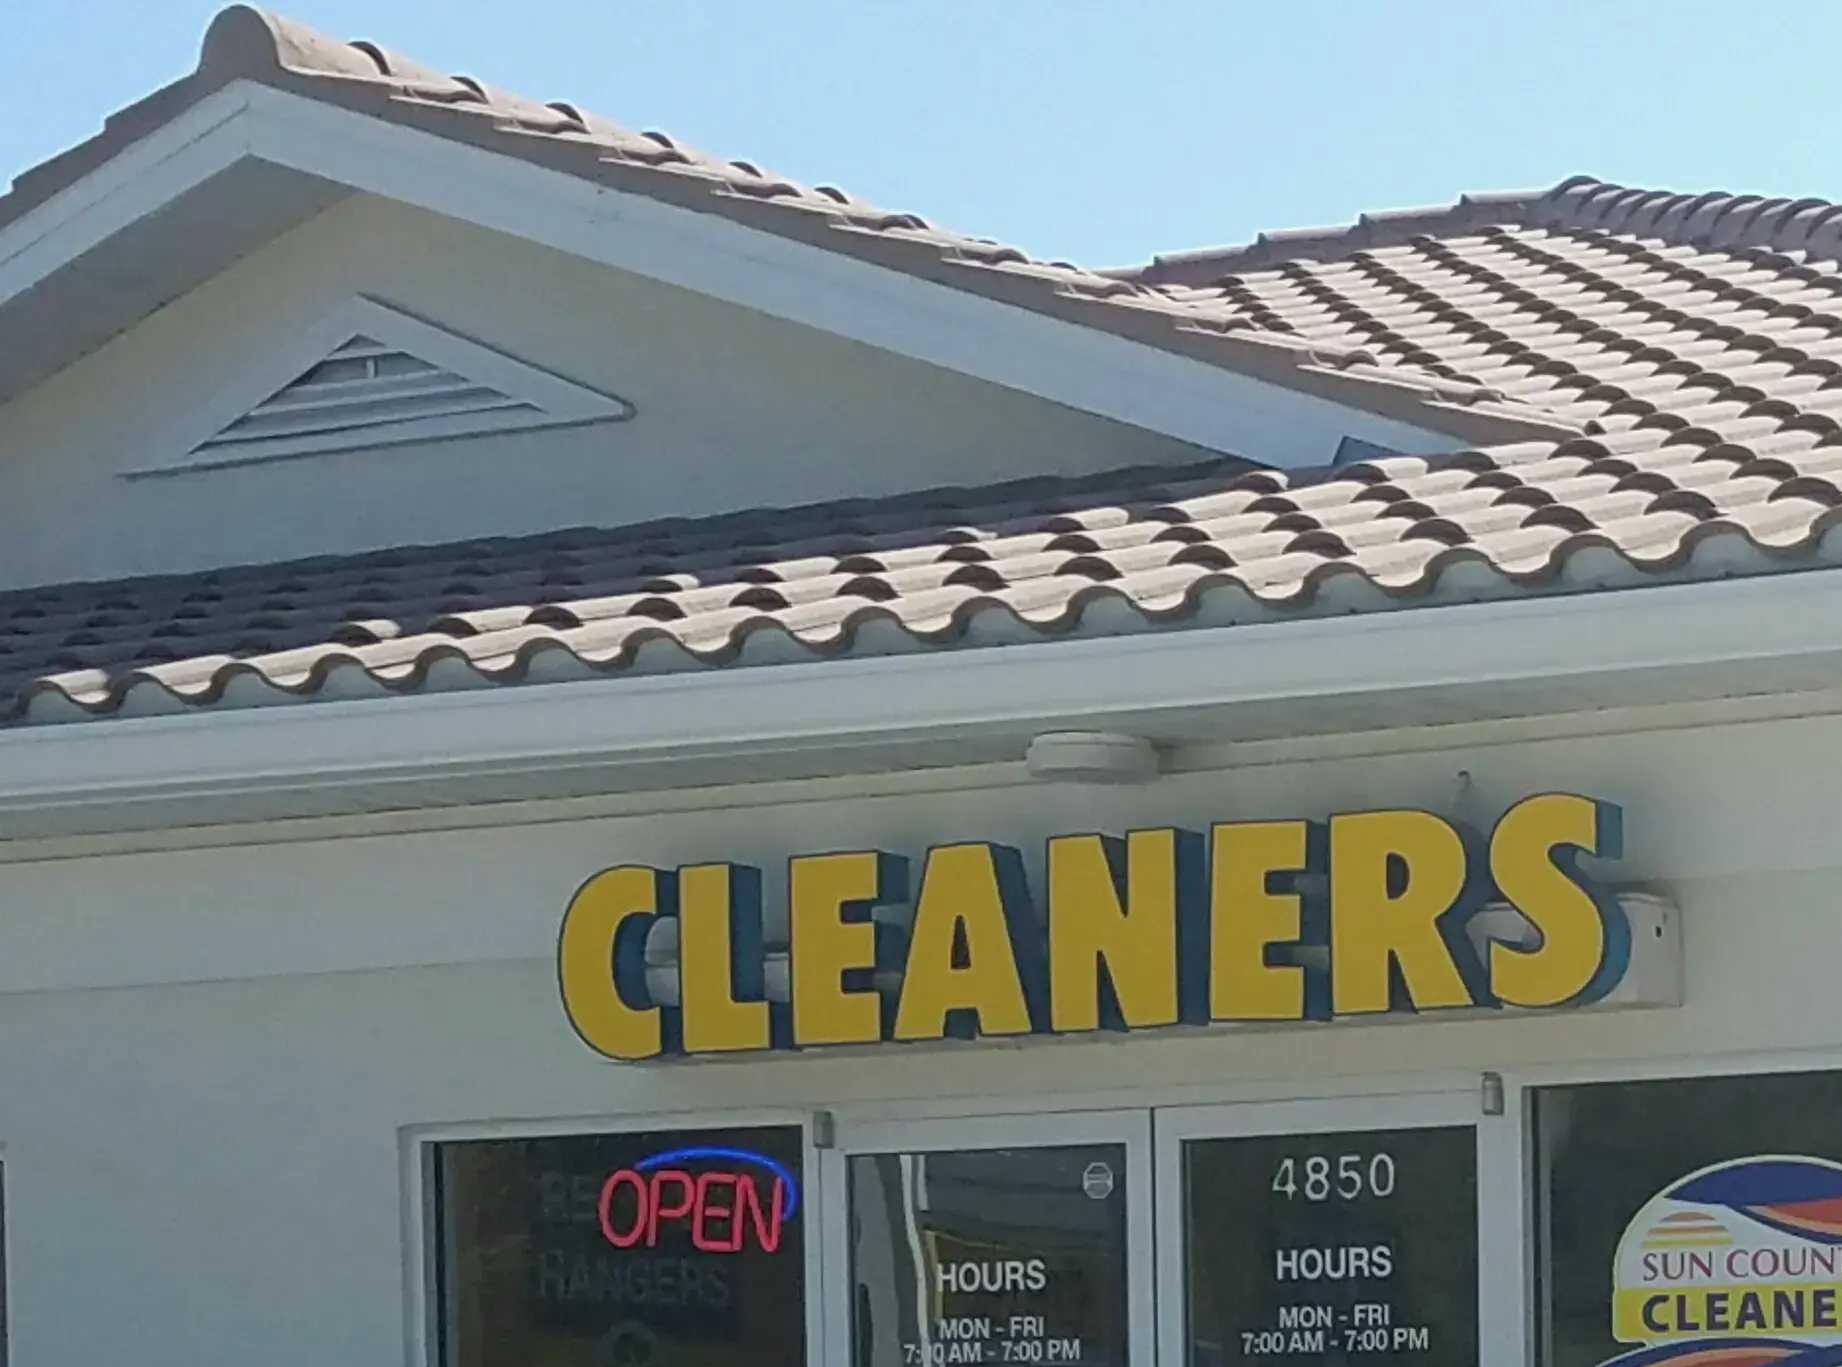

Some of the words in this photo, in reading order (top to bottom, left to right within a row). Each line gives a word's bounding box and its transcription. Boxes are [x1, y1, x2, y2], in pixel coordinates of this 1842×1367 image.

[558, 792, 1622, 1063] CLEANERS
[1272, 1153, 1396, 1200] 4850
[600, 1168, 782, 1253] OPEN
[936, 1260, 1047, 1293] HOURS
[1276, 1246, 1393, 1280] HOURS
[1643, 1250, 1713, 1282] SUN
[938, 1318, 991, 1340] MON
[1009, 1317, 1045, 1337] FRI
[1279, 1306, 1332, 1328] MON
[1354, 1304, 1390, 1325] FRI
[949, 1341, 982, 1362] AM
[1001, 1340, 1043, 1361] 7:00
[1047, 1338, 1081, 1360] PM
[1242, 1332, 1285, 1354] 7:00
[1288, 1331, 1324, 1352] AM
[1344, 1329, 1388, 1351] 7:00
[1393, 1327, 1429, 1350] PM
